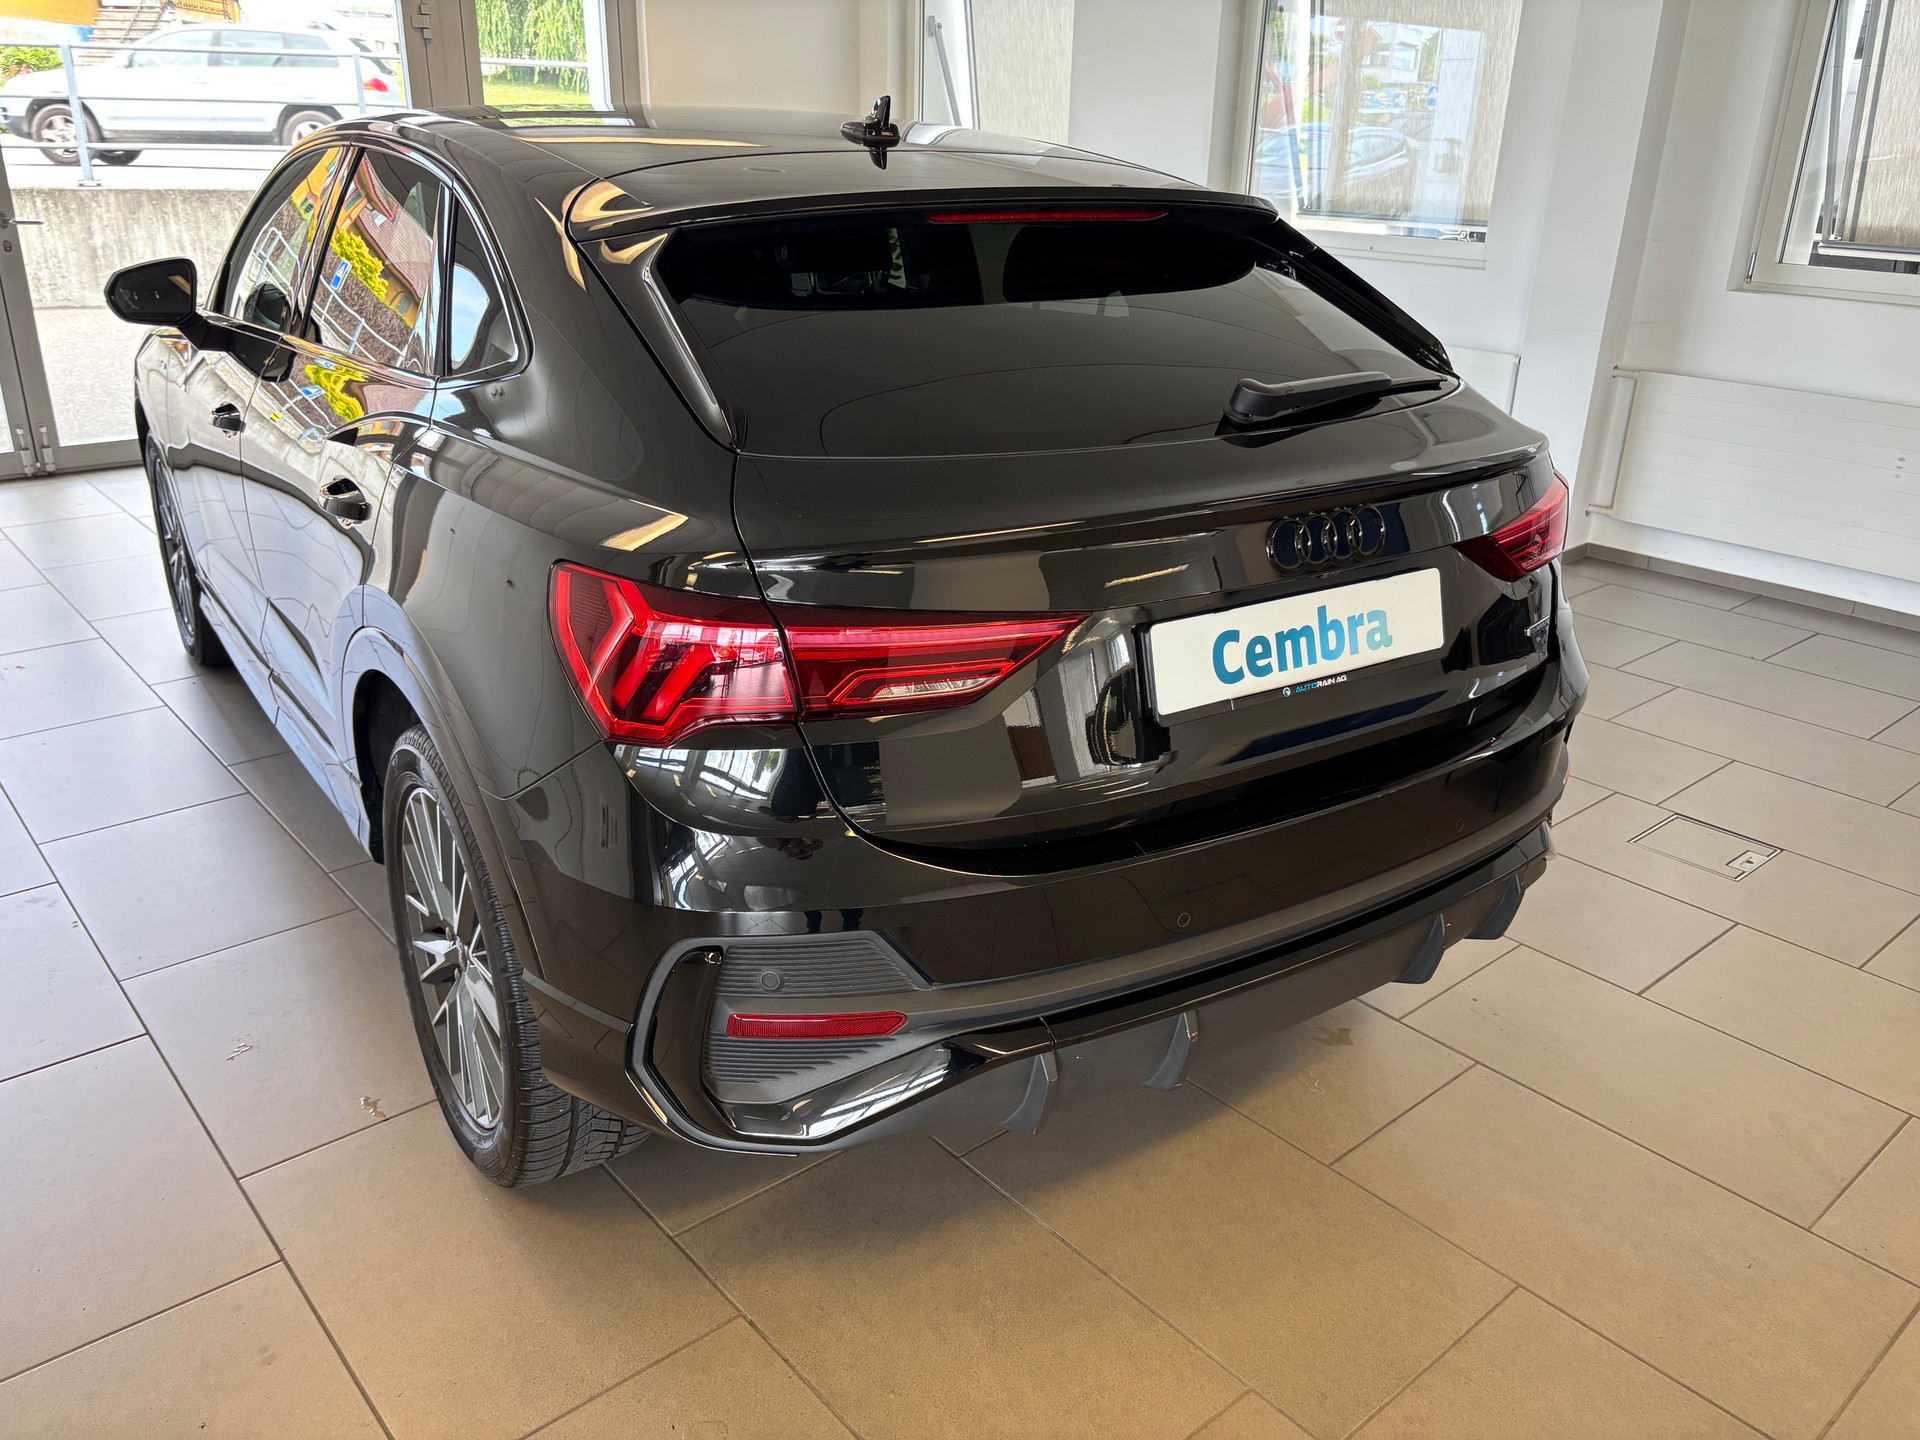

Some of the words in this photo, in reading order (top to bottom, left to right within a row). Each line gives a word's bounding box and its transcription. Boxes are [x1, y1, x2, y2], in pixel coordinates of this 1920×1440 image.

[1212, 604, 1393, 685] Cembra
[1295, 677, 1335, 693] AUTORAIN
[1336, 674, 1348, 683] AG
